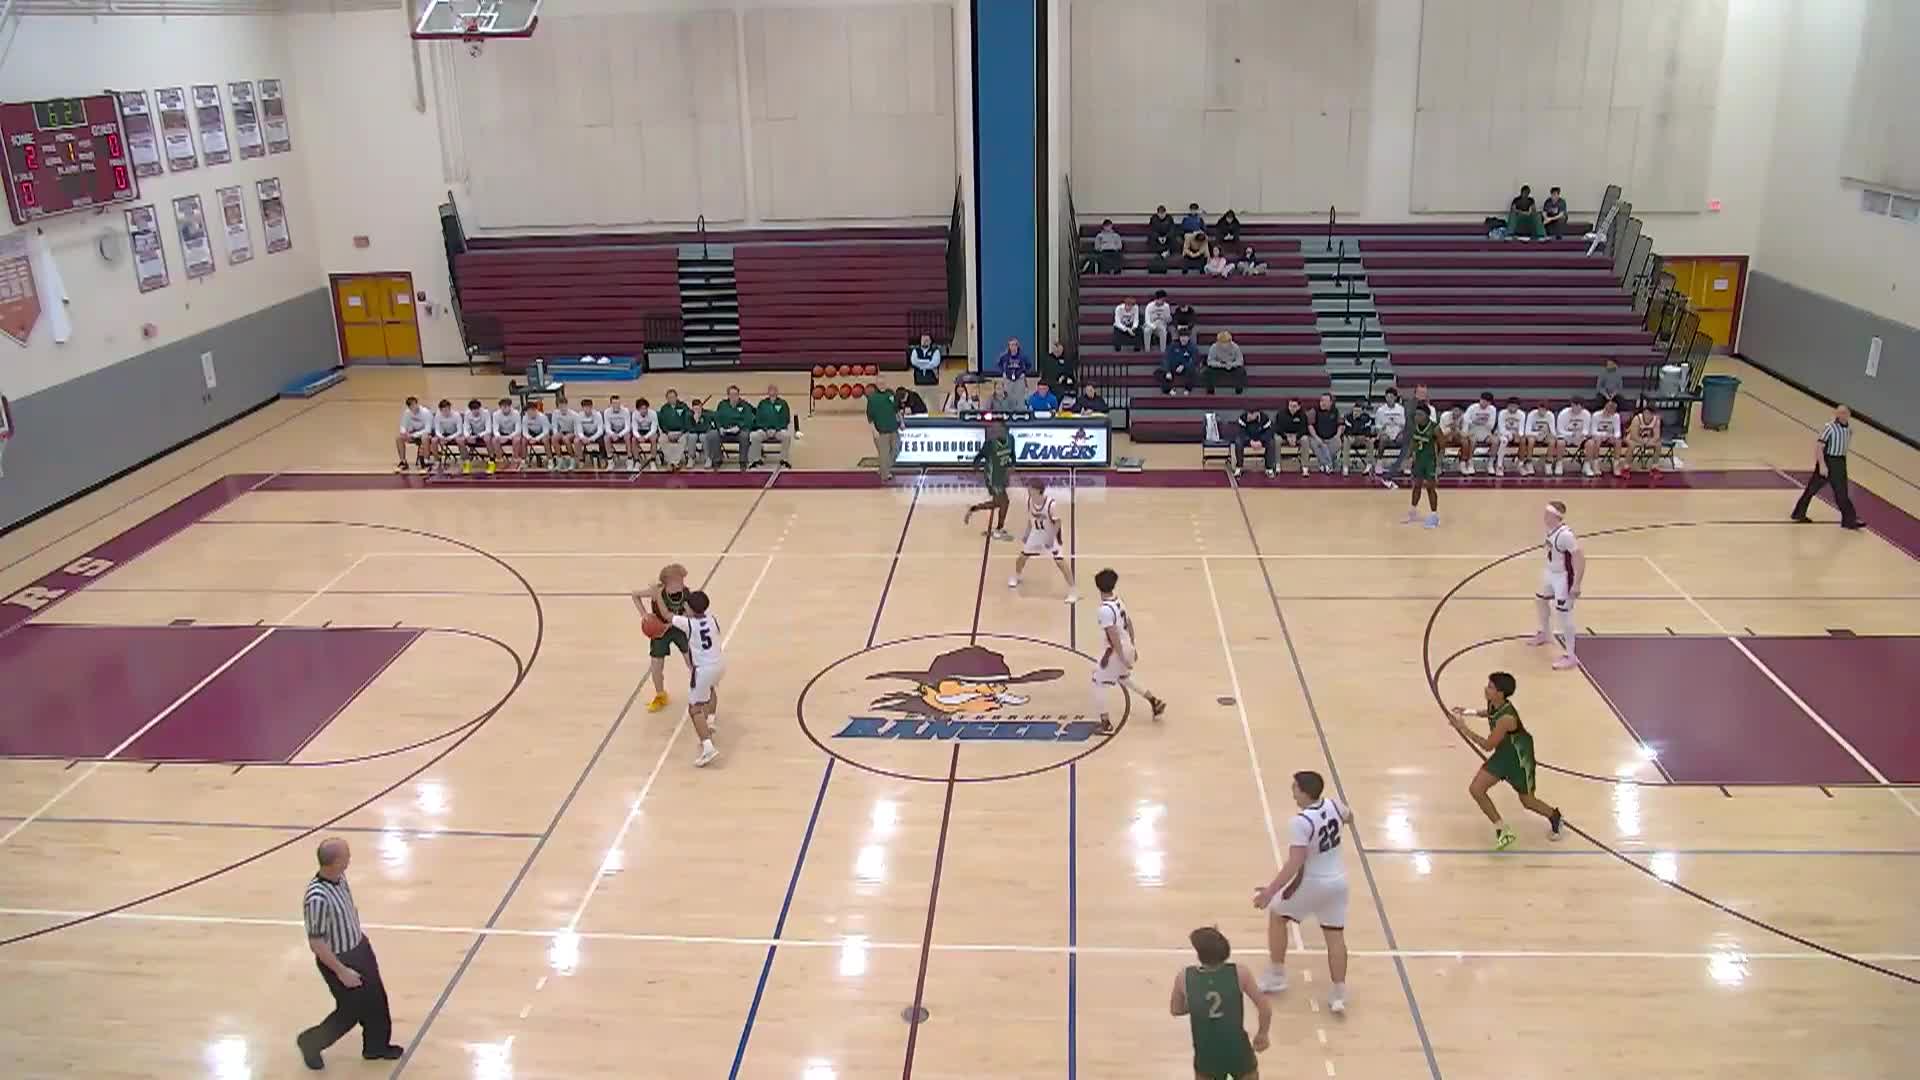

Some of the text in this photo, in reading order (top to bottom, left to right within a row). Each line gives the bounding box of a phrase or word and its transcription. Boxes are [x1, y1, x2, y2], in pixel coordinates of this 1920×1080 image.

[24, 144, 39, 169] 2
[107, 133, 121, 158] 0
[114, 166, 127, 189] 0
[1017, 440, 1098, 460] RANGERS
[699, 628, 713, 650] 5
[1318, 818, 1341, 854] 22
[1204, 990, 1224, 1019] 2
